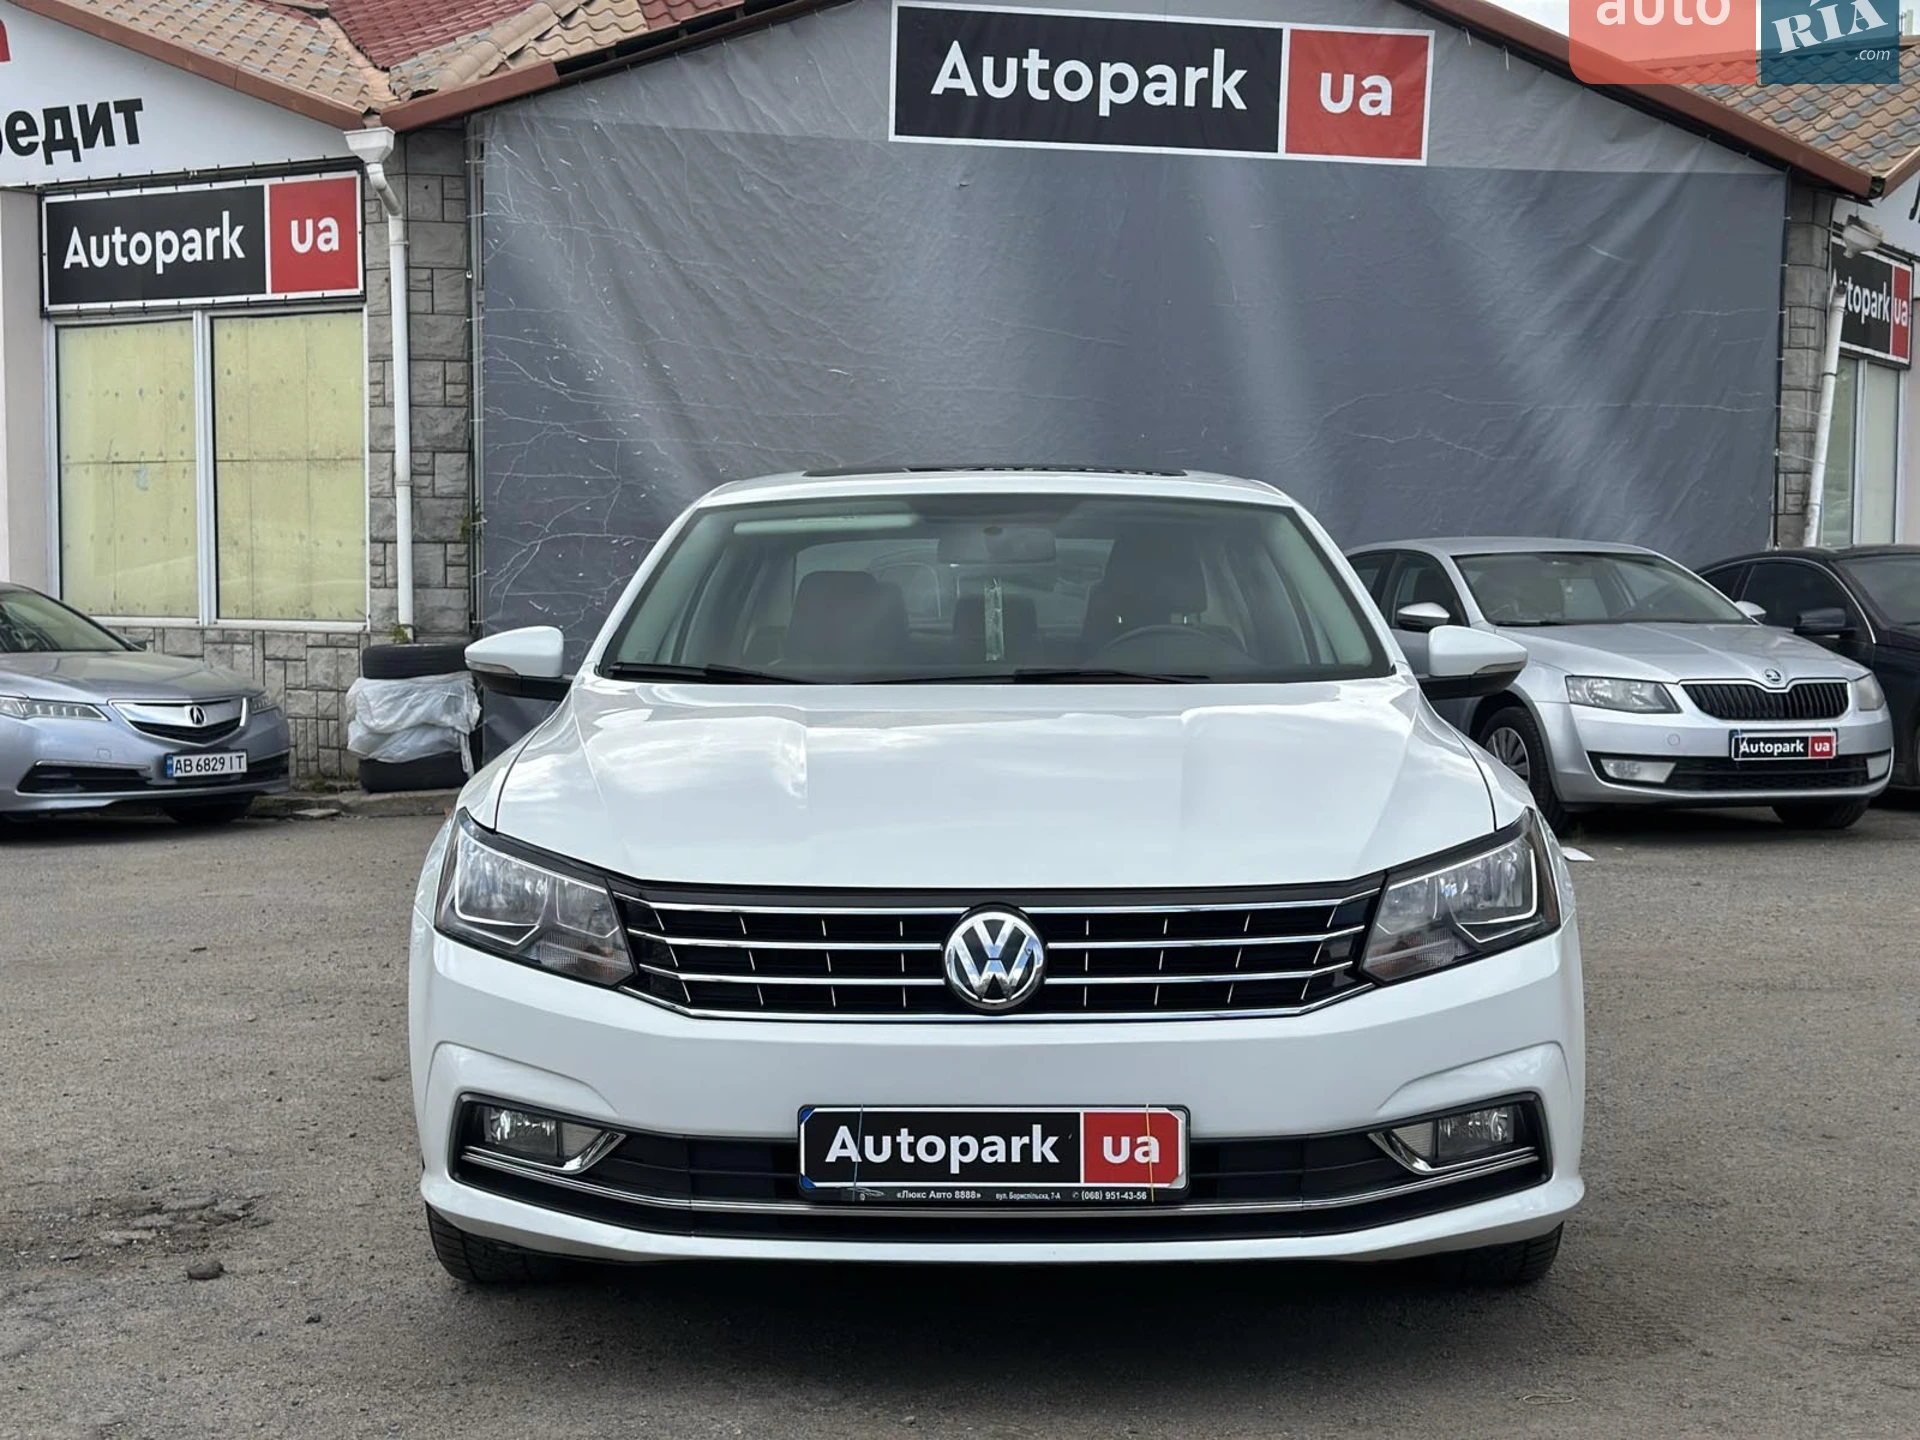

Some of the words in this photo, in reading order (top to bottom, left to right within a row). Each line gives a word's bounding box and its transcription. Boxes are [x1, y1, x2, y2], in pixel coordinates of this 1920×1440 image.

[930, 40, 1248, 117] Autopark
[1319, 72, 1393, 117] ua
[0, 98, 144, 166] едит
[63, 210, 246, 275] Autopark
[290, 216, 340, 254] ua
[1829, 268, 1891, 325] Atopark
[1893, 297, 1909, 327] ua
[174, 758, 194, 774] AB
[195, 756, 226, 773] 6829
[229, 754, 245, 771] IT
[1740, 739, 1805, 756] Autopark
[1814, 742, 1831, 752] ua
[825, 1124, 1060, 1174] Autopark
[1102, 1134, 1160, 1164] ua
[928, 1190, 953, 1199] Авто
[1081, 1190, 1103, 1201] (068)
[1105, 1190, 1147, 1200] 951-43-56
